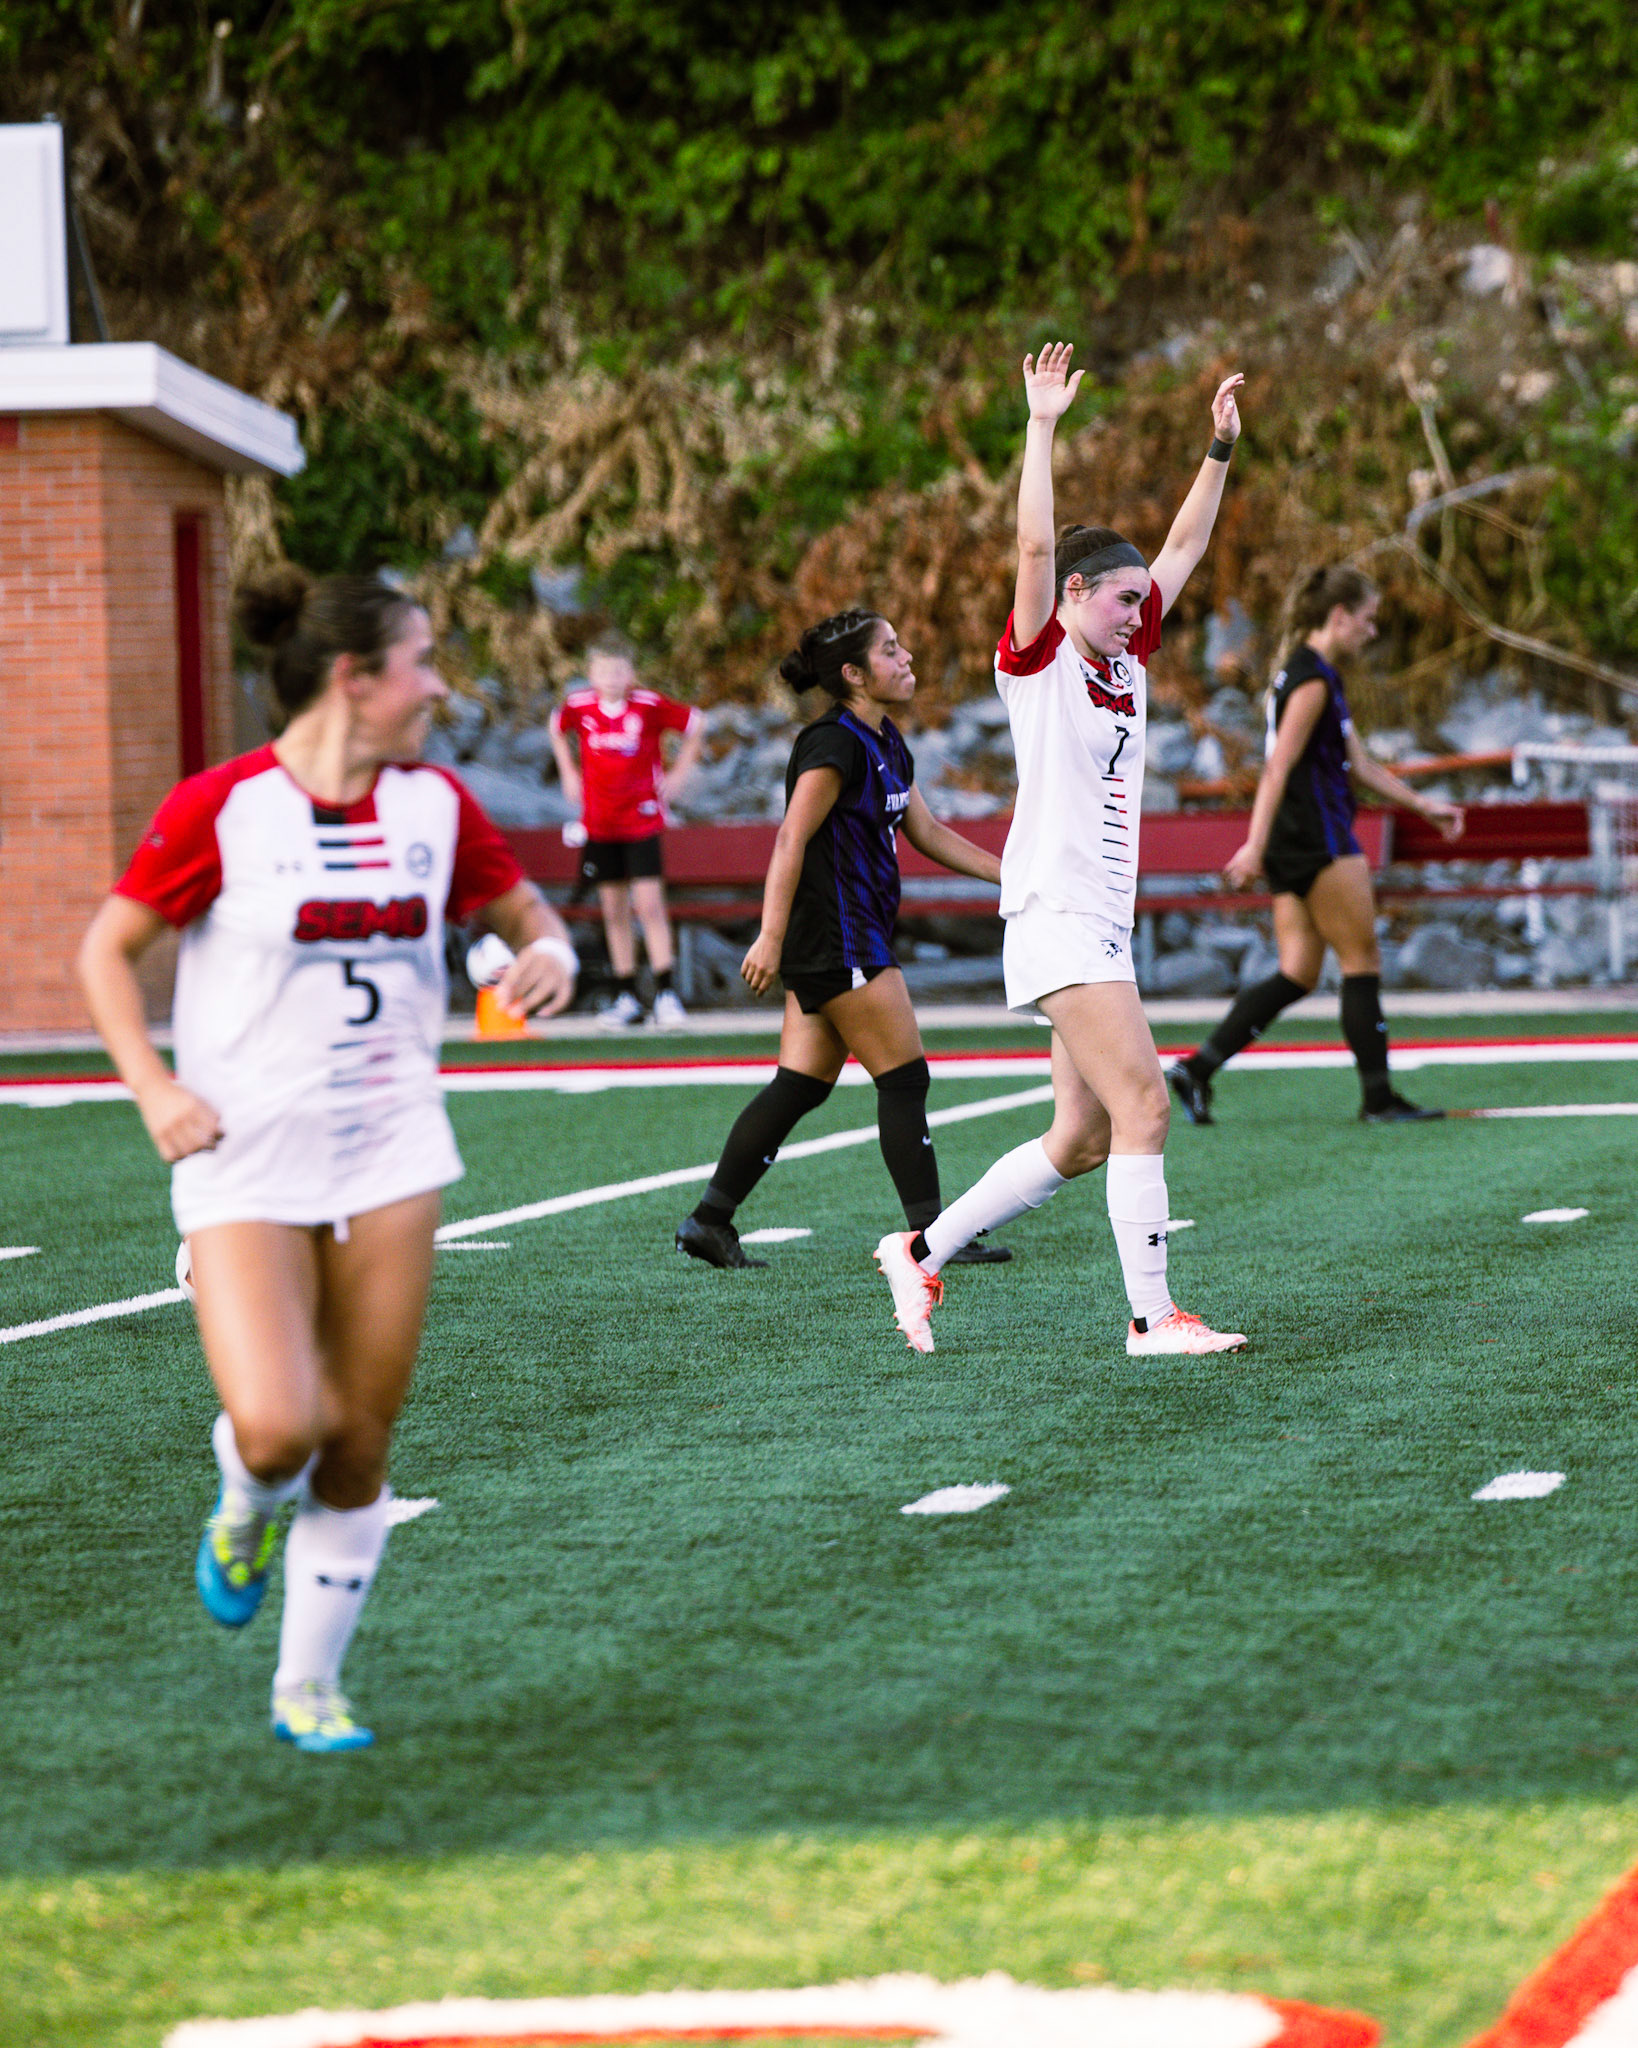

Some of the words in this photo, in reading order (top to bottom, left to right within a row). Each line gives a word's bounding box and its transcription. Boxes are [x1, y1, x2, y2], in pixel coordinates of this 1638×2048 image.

[1107, 724, 1130, 775] 7
[293, 894, 428, 944] SEMO
[342, 957, 381, 1025] 5
